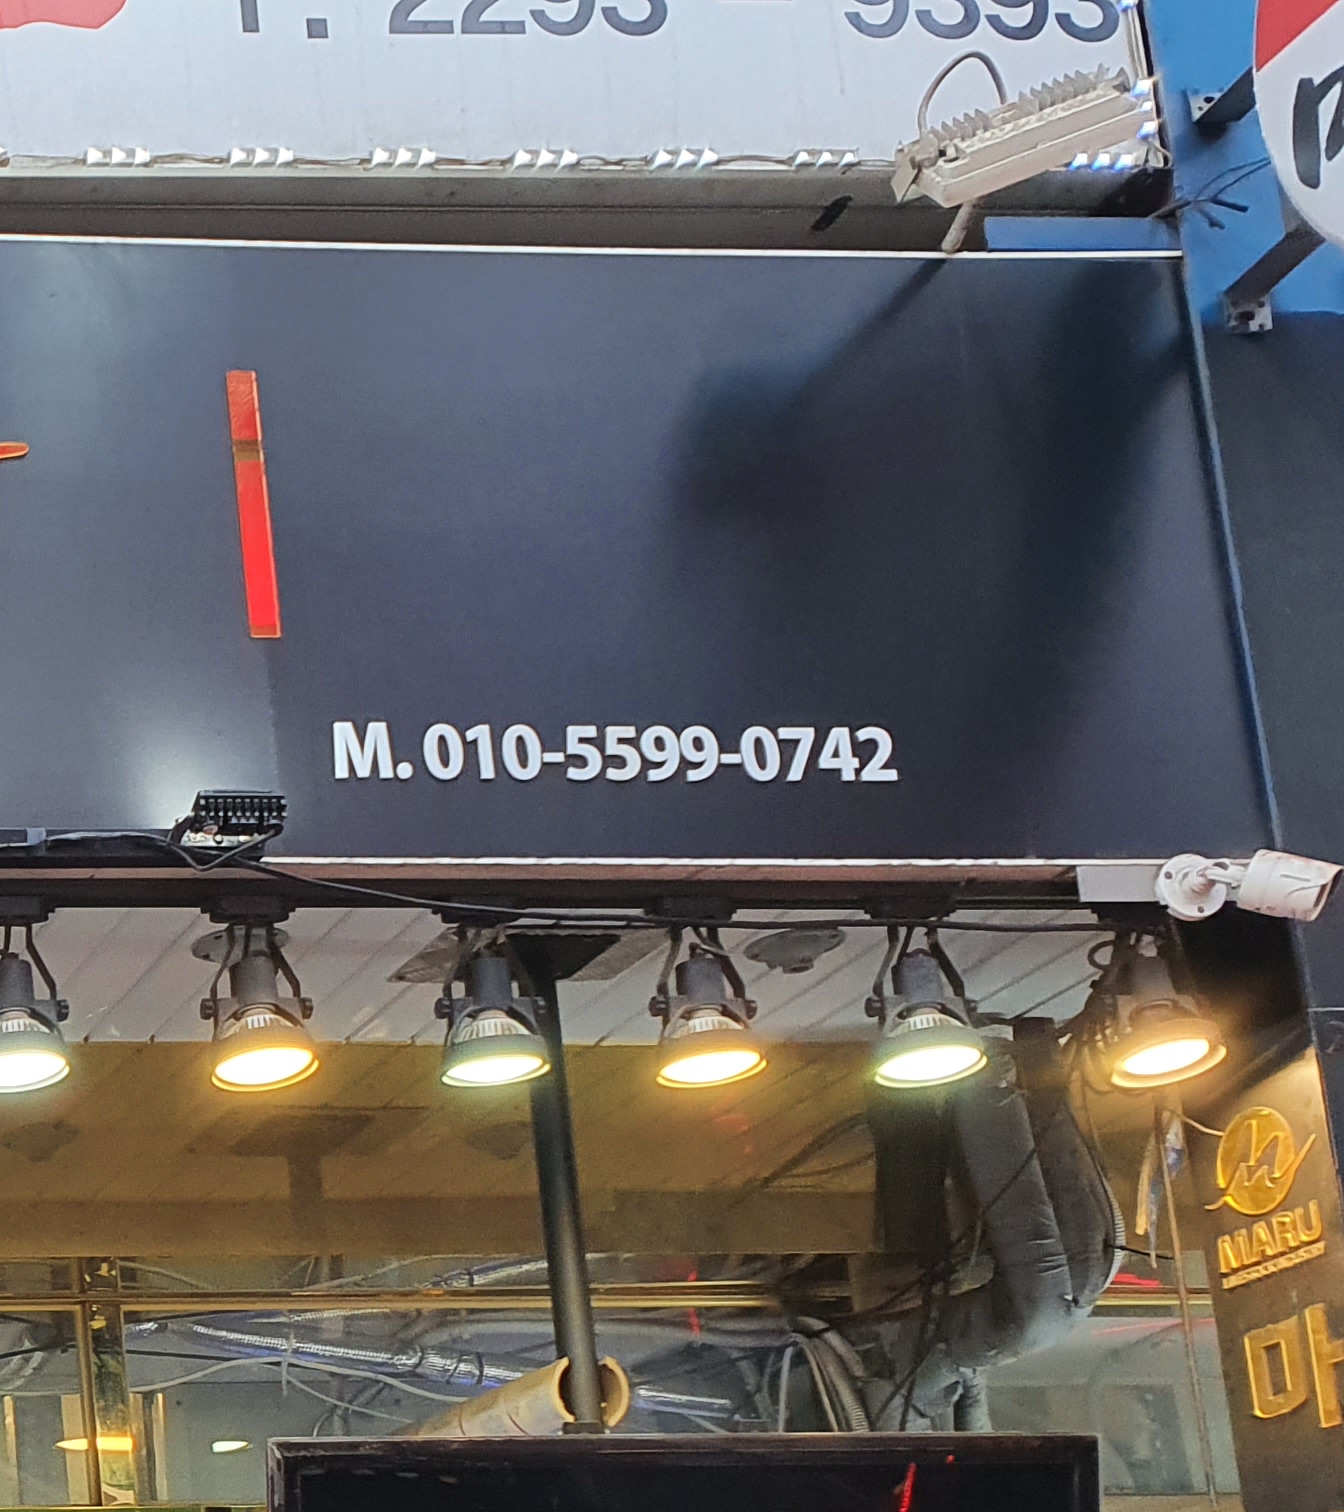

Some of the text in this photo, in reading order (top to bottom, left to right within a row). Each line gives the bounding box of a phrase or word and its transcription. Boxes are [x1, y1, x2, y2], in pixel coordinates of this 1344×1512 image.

[332, 720, 899, 783] M. 010-5599-0742
[1217, 1199, 1323, 1274] MARU
